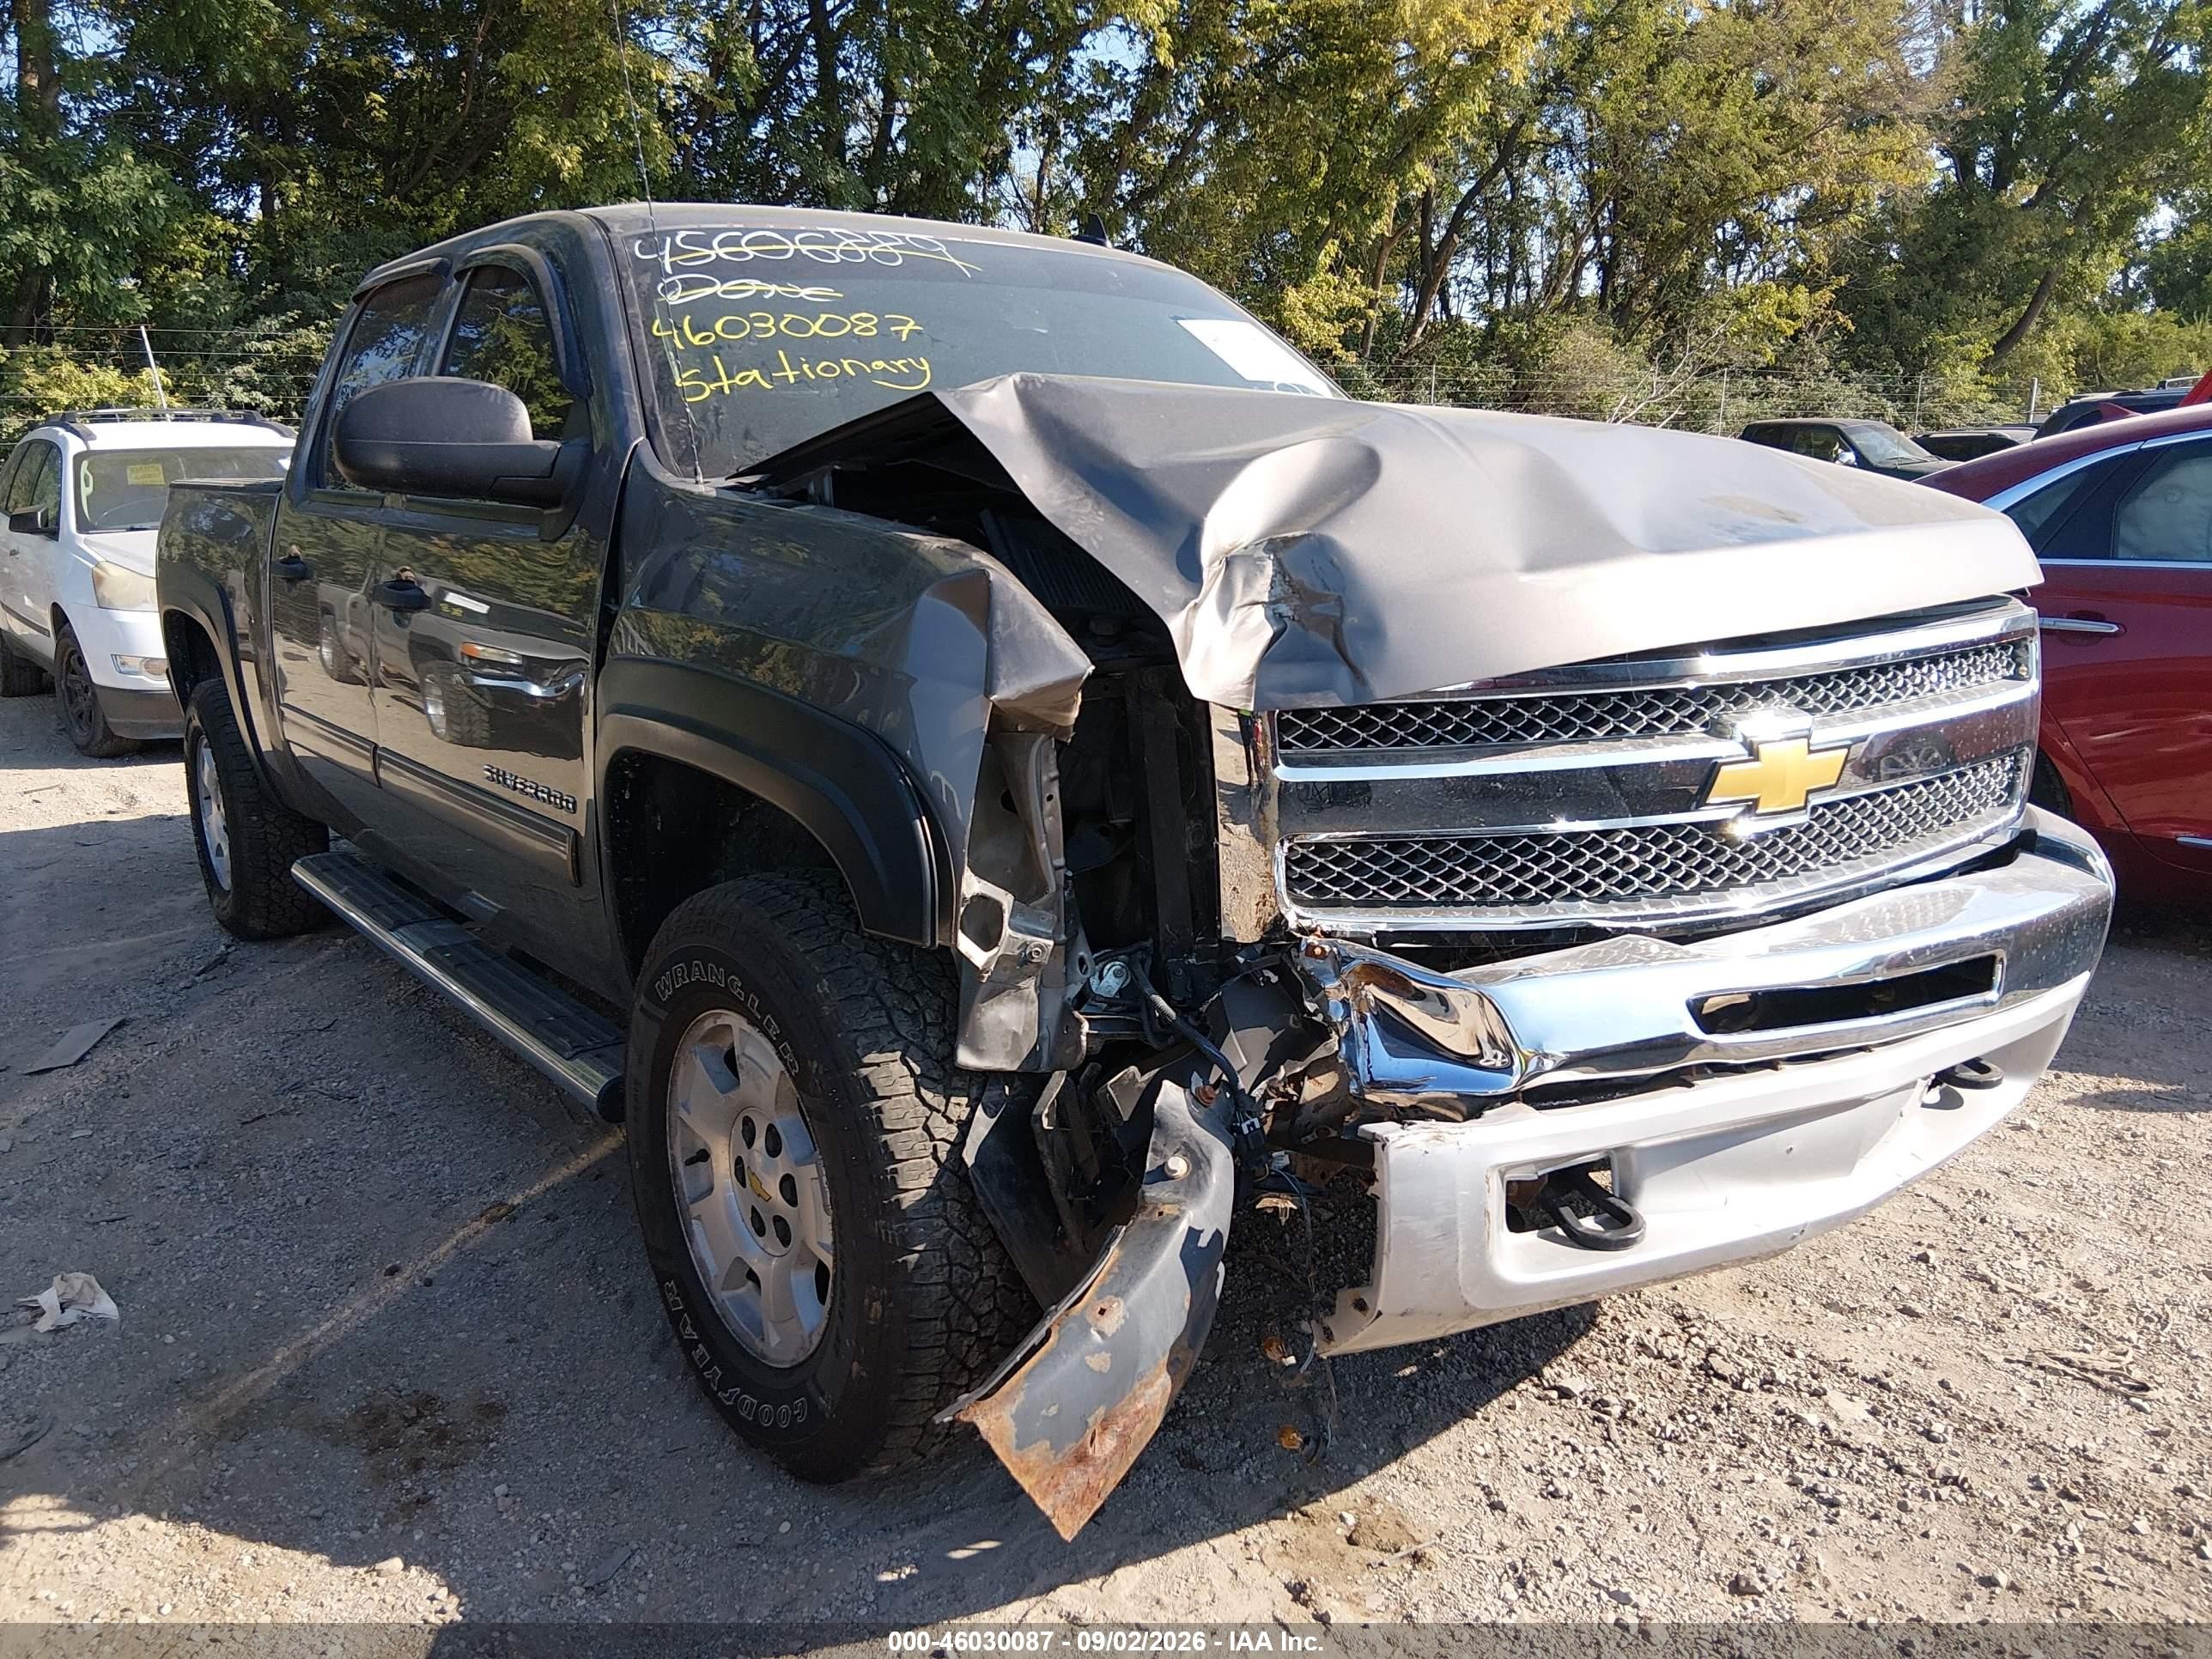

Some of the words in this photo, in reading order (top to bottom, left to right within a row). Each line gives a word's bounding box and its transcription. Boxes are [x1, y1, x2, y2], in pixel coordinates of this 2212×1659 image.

[652, 312, 924, 350] 46030087
[675, 349, 932, 402] Stationary
[654, 960, 799, 1075] WRANGLER
[664, 1279, 808, 1428] GOODYEAR
